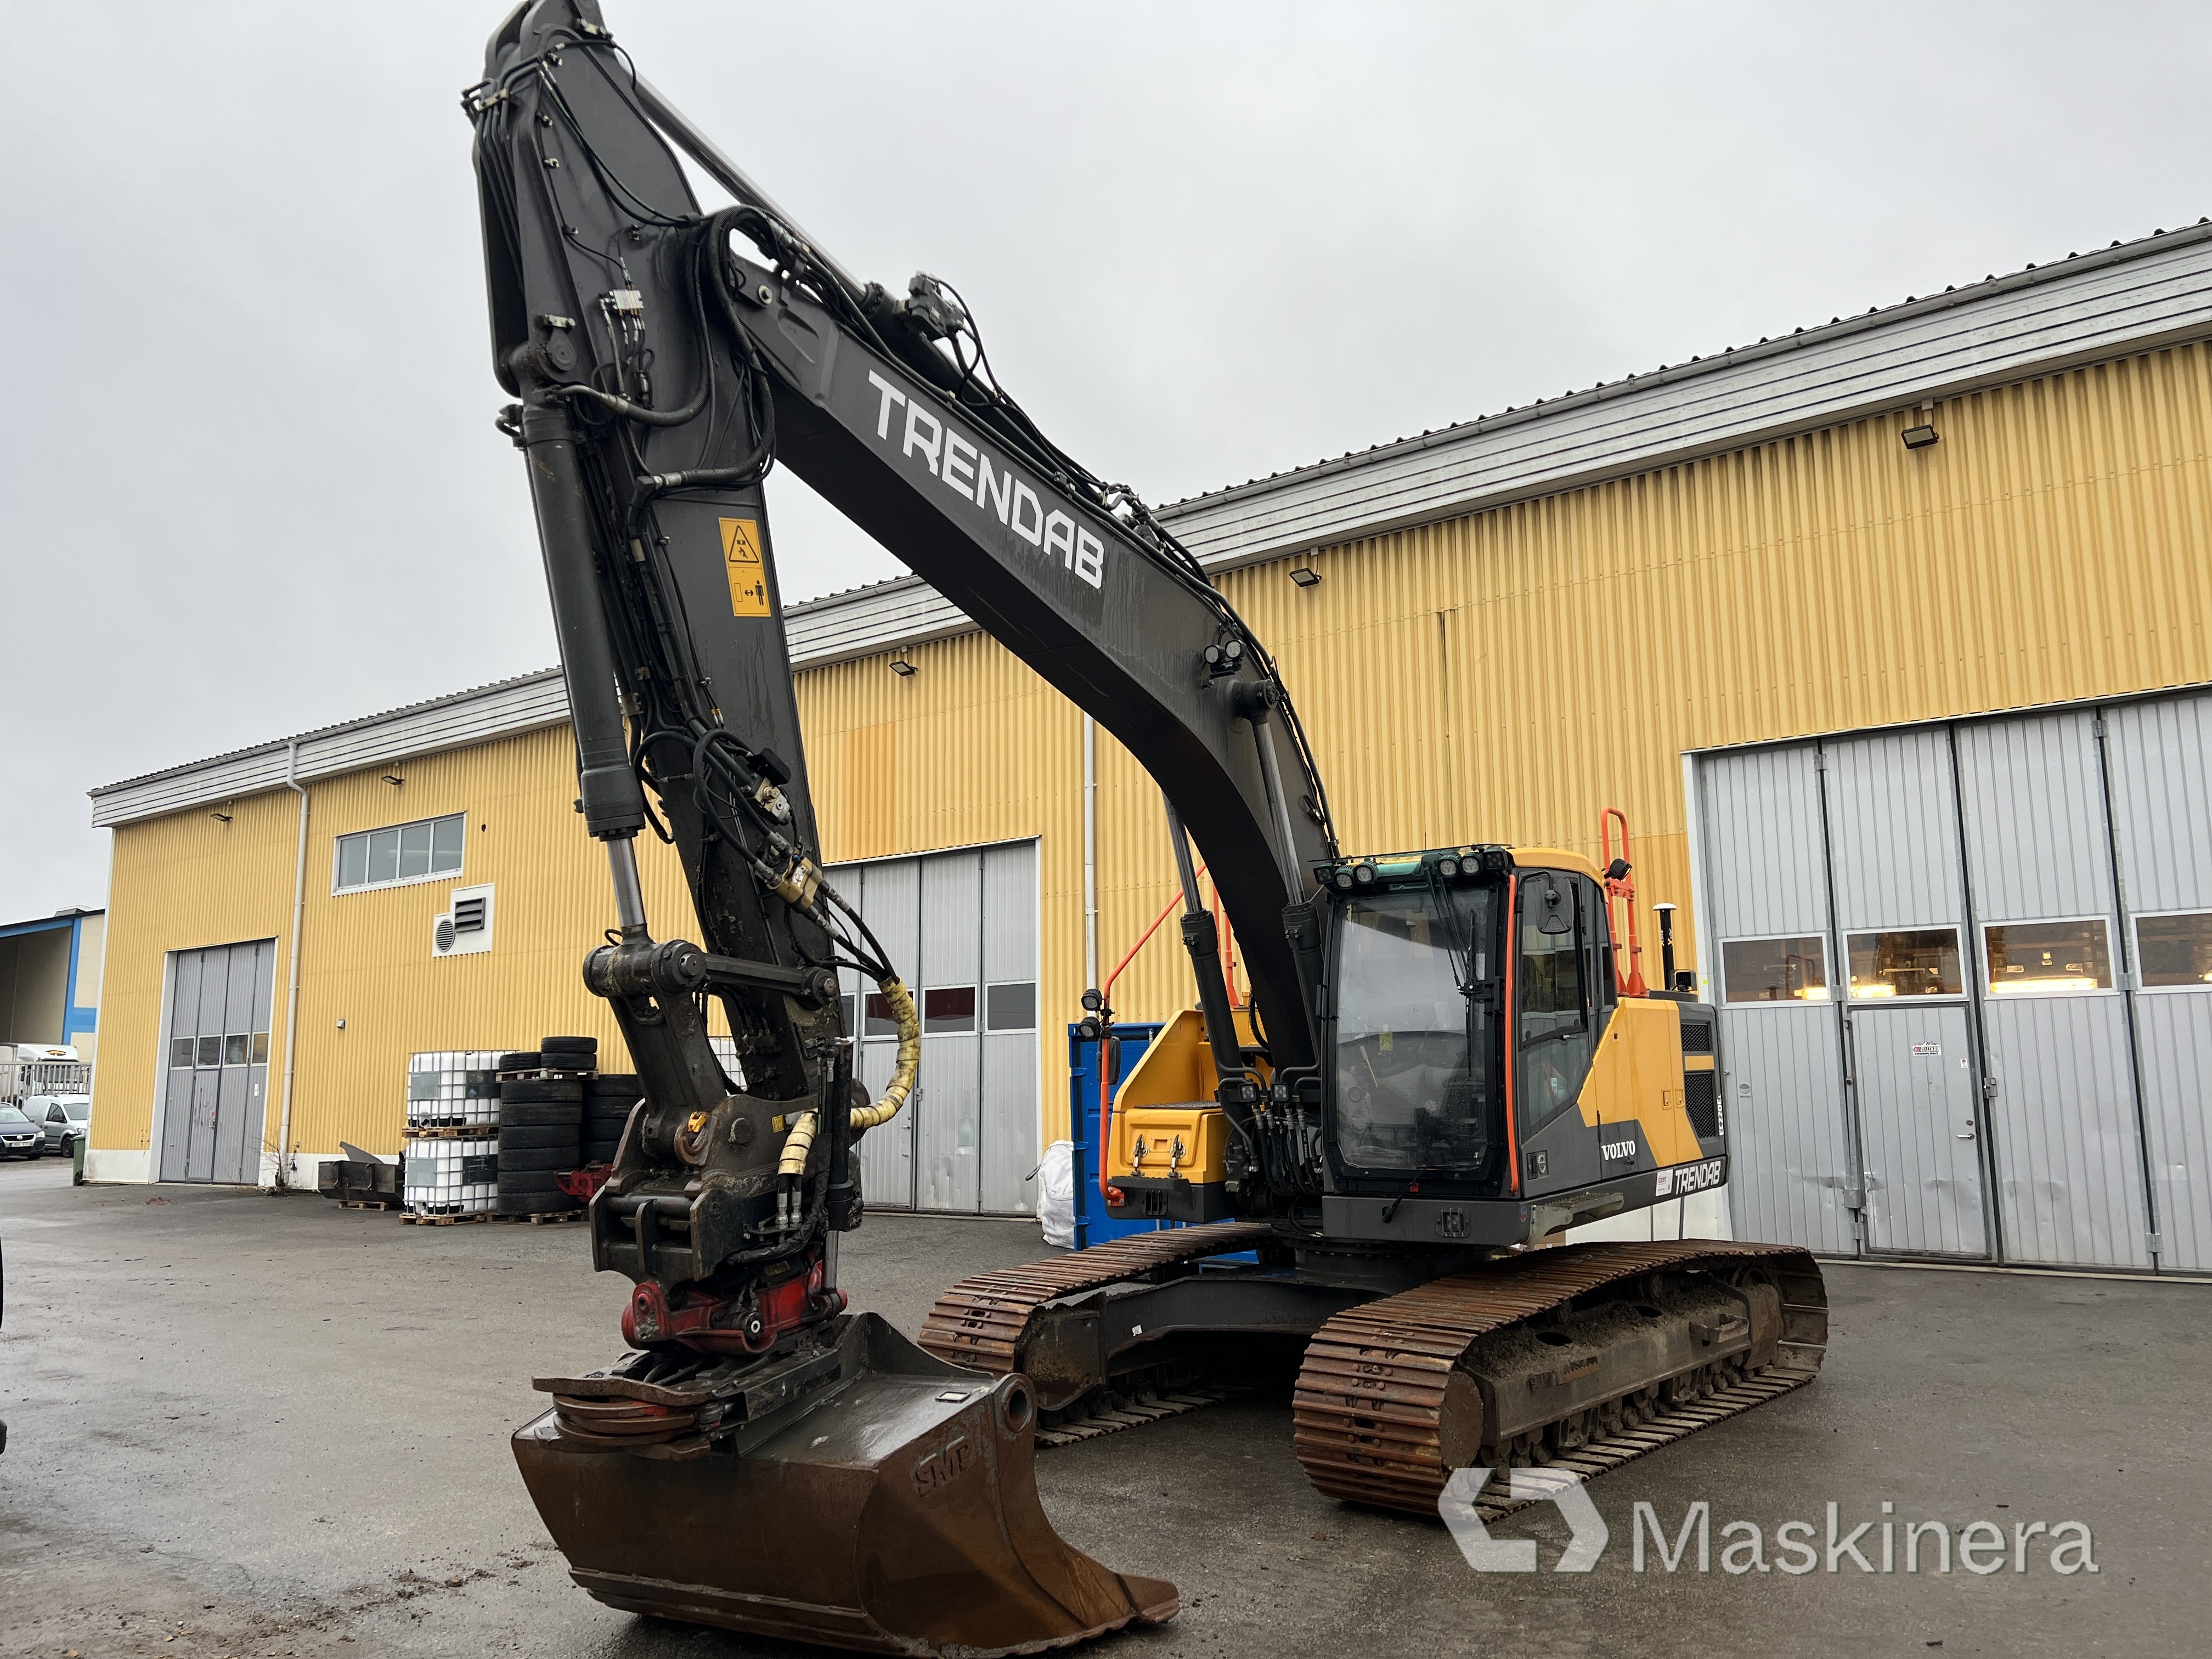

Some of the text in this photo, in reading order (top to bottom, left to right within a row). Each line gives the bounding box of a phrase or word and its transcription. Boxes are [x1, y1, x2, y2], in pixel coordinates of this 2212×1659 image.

[868, 369, 1104, 590] TRENDAB
[1601, 1140, 1636, 1161] VOLVO
[1675, 1160, 1722, 1195] TRENDAB
